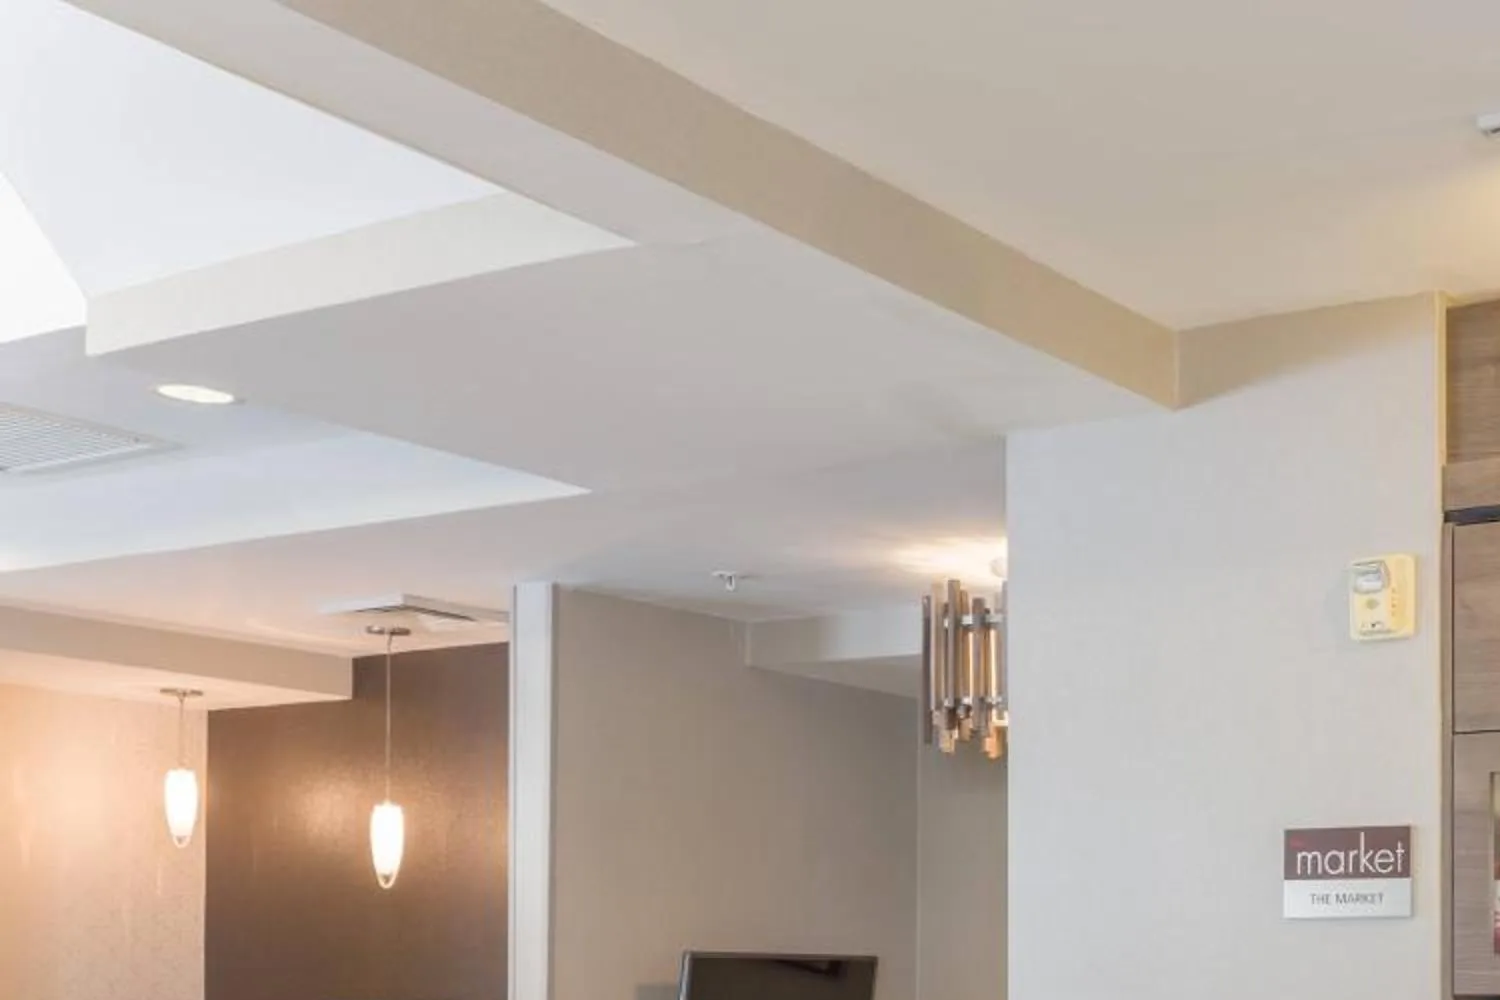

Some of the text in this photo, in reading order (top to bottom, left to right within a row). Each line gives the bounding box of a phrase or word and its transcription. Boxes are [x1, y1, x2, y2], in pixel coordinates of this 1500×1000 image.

[1296, 831, 1405, 875] market
[1310, 892, 1384, 905] THE MARKET
